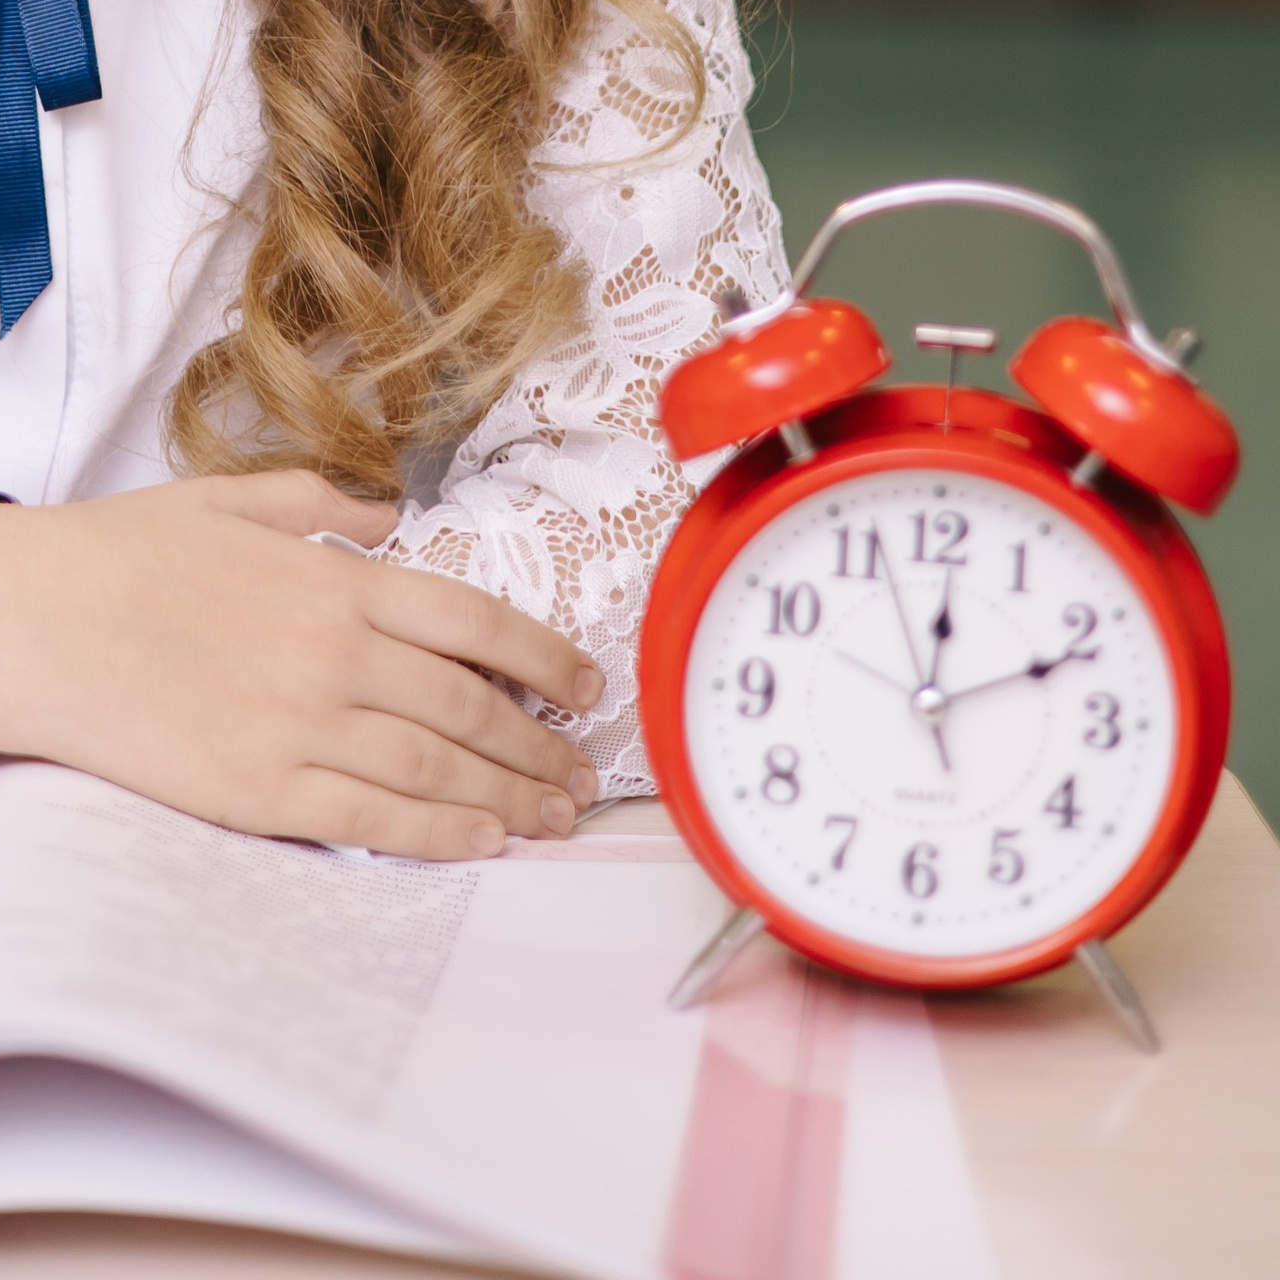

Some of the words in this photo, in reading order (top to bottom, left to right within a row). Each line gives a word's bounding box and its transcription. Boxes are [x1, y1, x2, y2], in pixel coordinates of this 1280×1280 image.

[832, 523, 881, 579] 11
[907, 510, 969, 564] 12
[1010, 542, 1030, 592] 1
[763, 581, 820, 636] 10
[1061, 603, 1104, 661] 2
[738, 657, 775, 718] 9
[1083, 692, 1121, 749] 3
[762, 745, 800, 804] 8
[1044, 774, 1083, 830] 4
[824, 816, 858, 871] 7
[902, 843, 938, 899] 6
[988, 829, 1025, 883] 5
